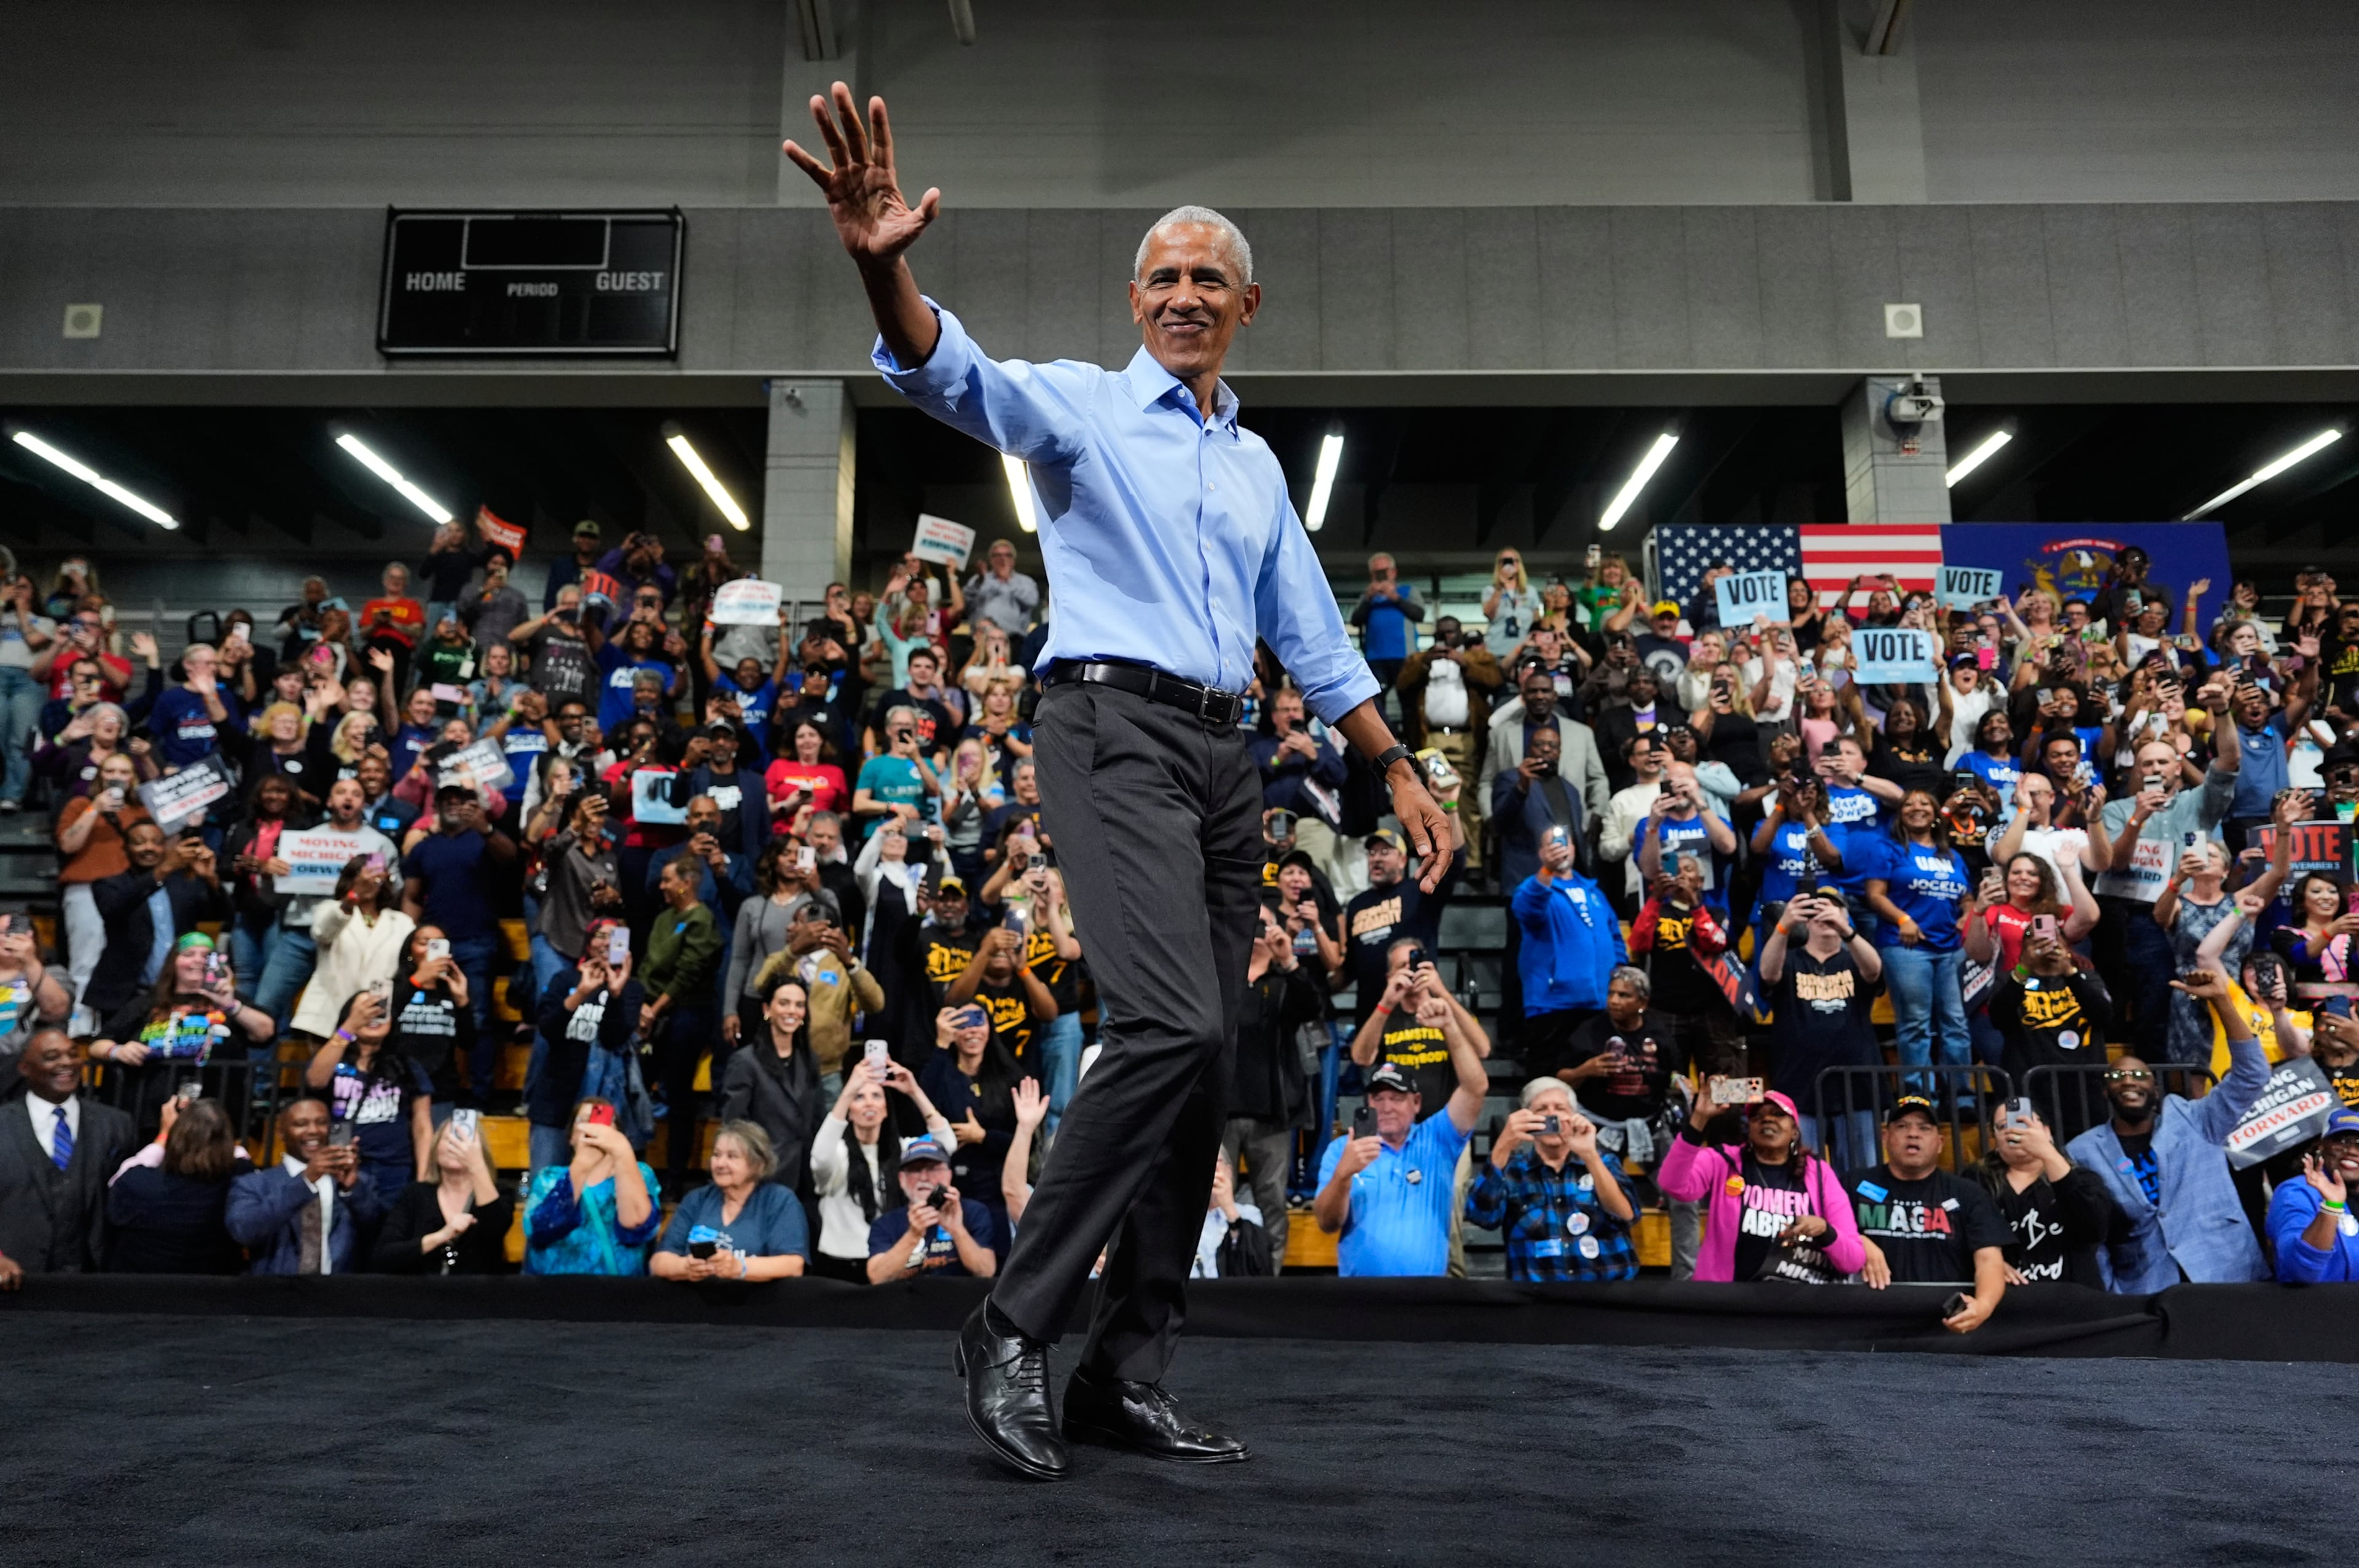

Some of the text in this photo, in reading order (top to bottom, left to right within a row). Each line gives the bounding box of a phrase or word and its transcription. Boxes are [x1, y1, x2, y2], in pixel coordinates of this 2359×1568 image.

[406, 272, 466, 291] HOME
[507, 283, 558, 297] PERIOD
[596, 271, 664, 291] GUEST
[1726, 575, 1778, 605] VOTE
[1946, 570, 1993, 595] VOTE
[1863, 633, 1925, 661] VOTE
[299, 838, 360, 848] MOVING
[2138, 844, 2159, 854] ING
[2261, 825, 2341, 862] VOTE
[291, 851, 355, 860] MICHIG
[1915, 856, 1955, 873] UAW
[1050, 960, 1068, 984] 7
[1015, 1029, 1031, 1056] 7
[1384, 1027, 1445, 1046] TEAMSTER
[1385, 1050, 1449, 1071] EVERYBODY
[2263, 1069, 2298, 1093] ING
[2241, 1077, 2317, 1124] CHIGAN
[2232, 1093, 2326, 1144] FORWARD
[1742, 1208, 1794, 1238] ABD
[1858, 1204, 1952, 1233] MAGA
[2020, 1207, 2064, 1250] Be
[2018, 1254, 2064, 1281] ind
